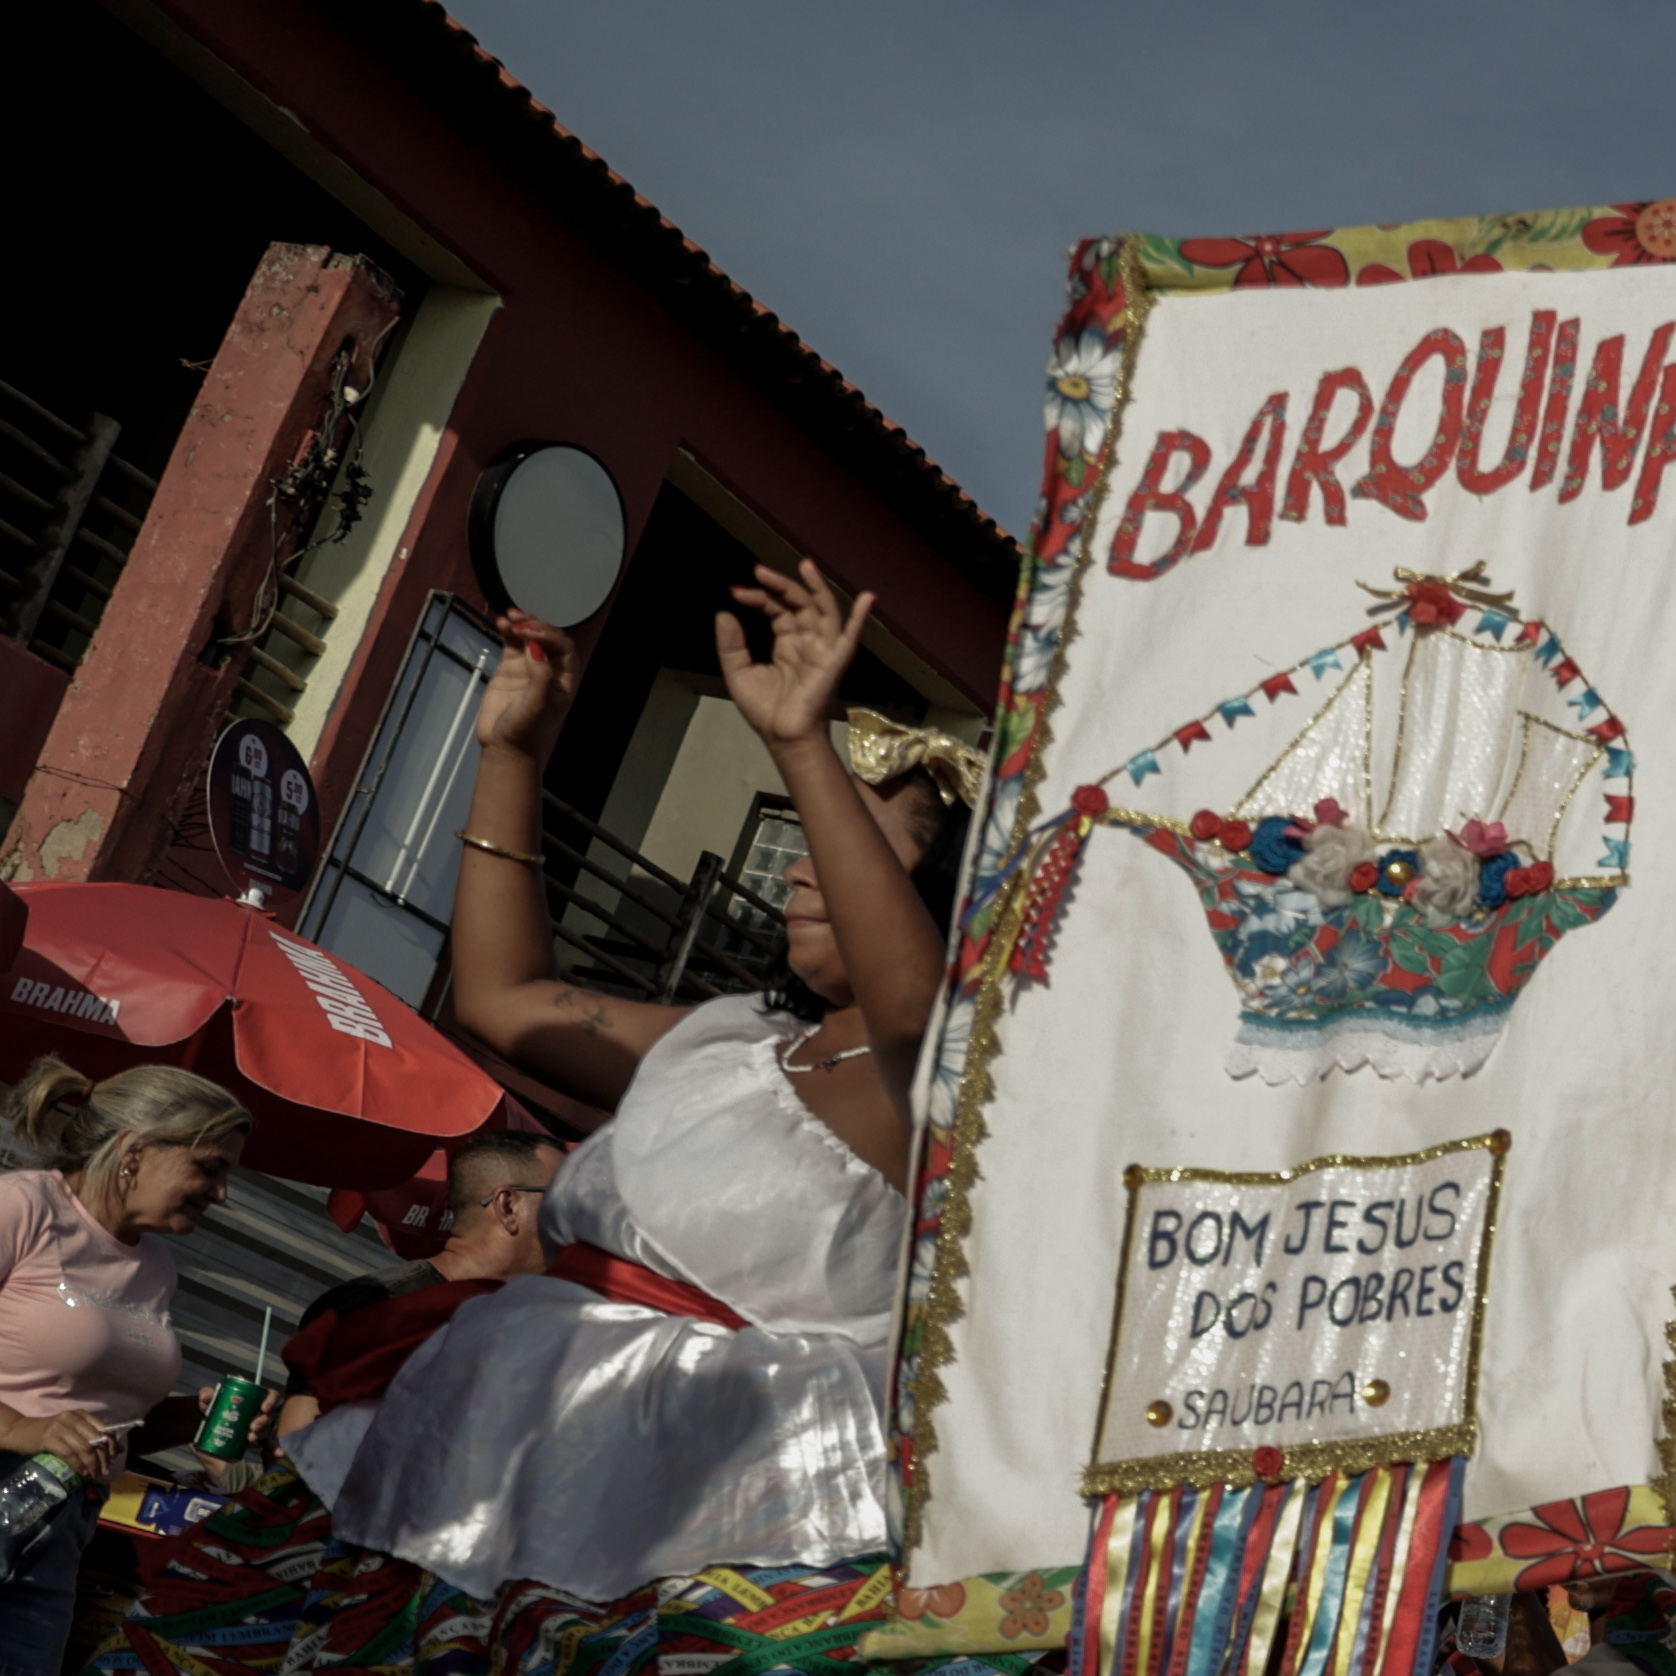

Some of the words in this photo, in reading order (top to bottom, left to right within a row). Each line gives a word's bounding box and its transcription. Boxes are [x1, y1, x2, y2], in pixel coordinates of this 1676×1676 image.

[10, 977, 121, 1026] BRAHMA
[268, 930, 394, 1049] BRAHMA
[1148, 1209, 1272, 1270] BOM
[1284, 1182, 1461, 1255] JESUS
[1189, 1282, 1277, 1339] DOS
[1297, 1261, 1464, 1330] POBRES
[1178, 1371, 1356, 1431] SAUBARA
[273, 1556, 318, 1582] BAHIA
[284, 1630, 327, 1671] BAHIA
